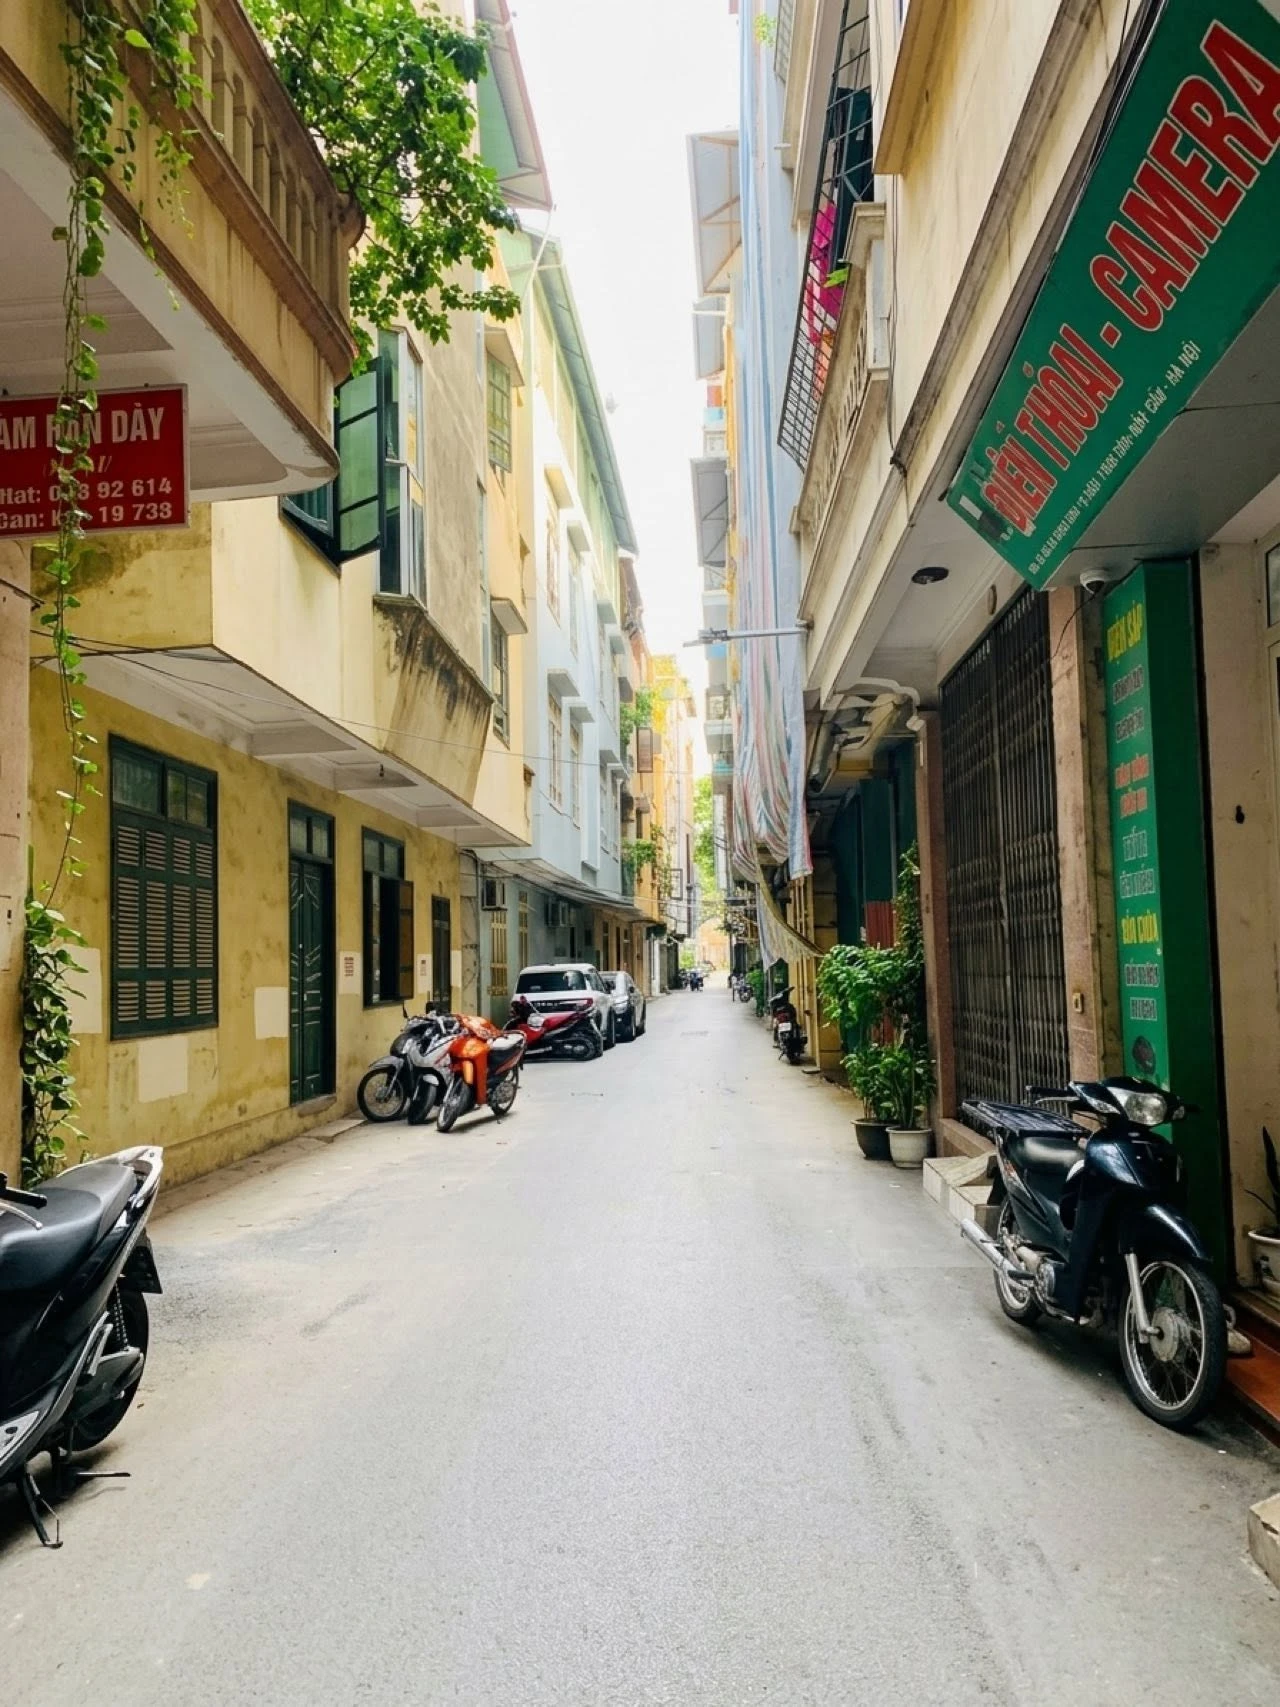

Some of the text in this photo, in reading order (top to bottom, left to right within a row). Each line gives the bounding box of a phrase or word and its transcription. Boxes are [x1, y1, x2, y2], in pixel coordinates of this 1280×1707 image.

[1089, 19, 1280, 332] CAMERA
[97, 480, 124, 499] 92
[131, 477, 172, 497] 614
[99, 505, 124, 523] 19
